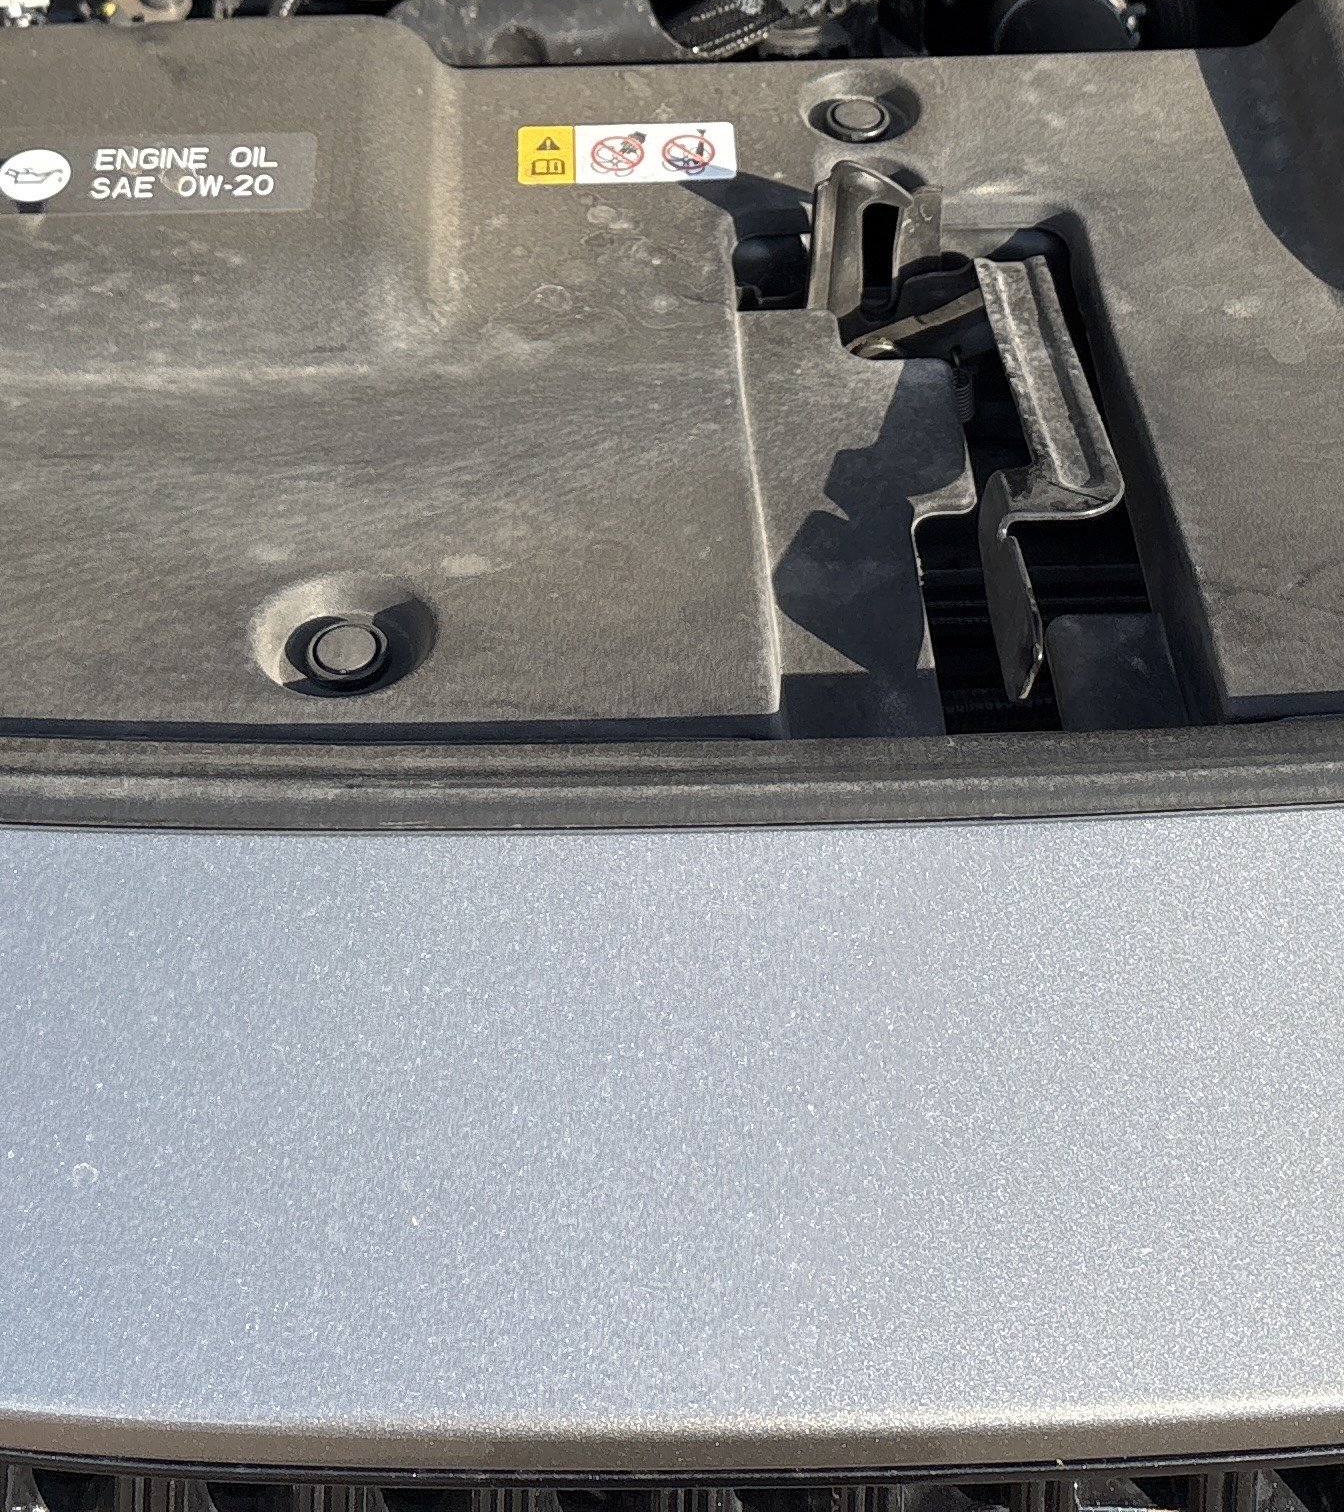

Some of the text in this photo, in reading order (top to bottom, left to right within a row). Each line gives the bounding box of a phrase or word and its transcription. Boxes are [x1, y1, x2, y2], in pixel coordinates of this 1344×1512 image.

[94, 146, 278, 171] ENGINE OIL
[90, 174, 275, 199] SAE 0W-20
